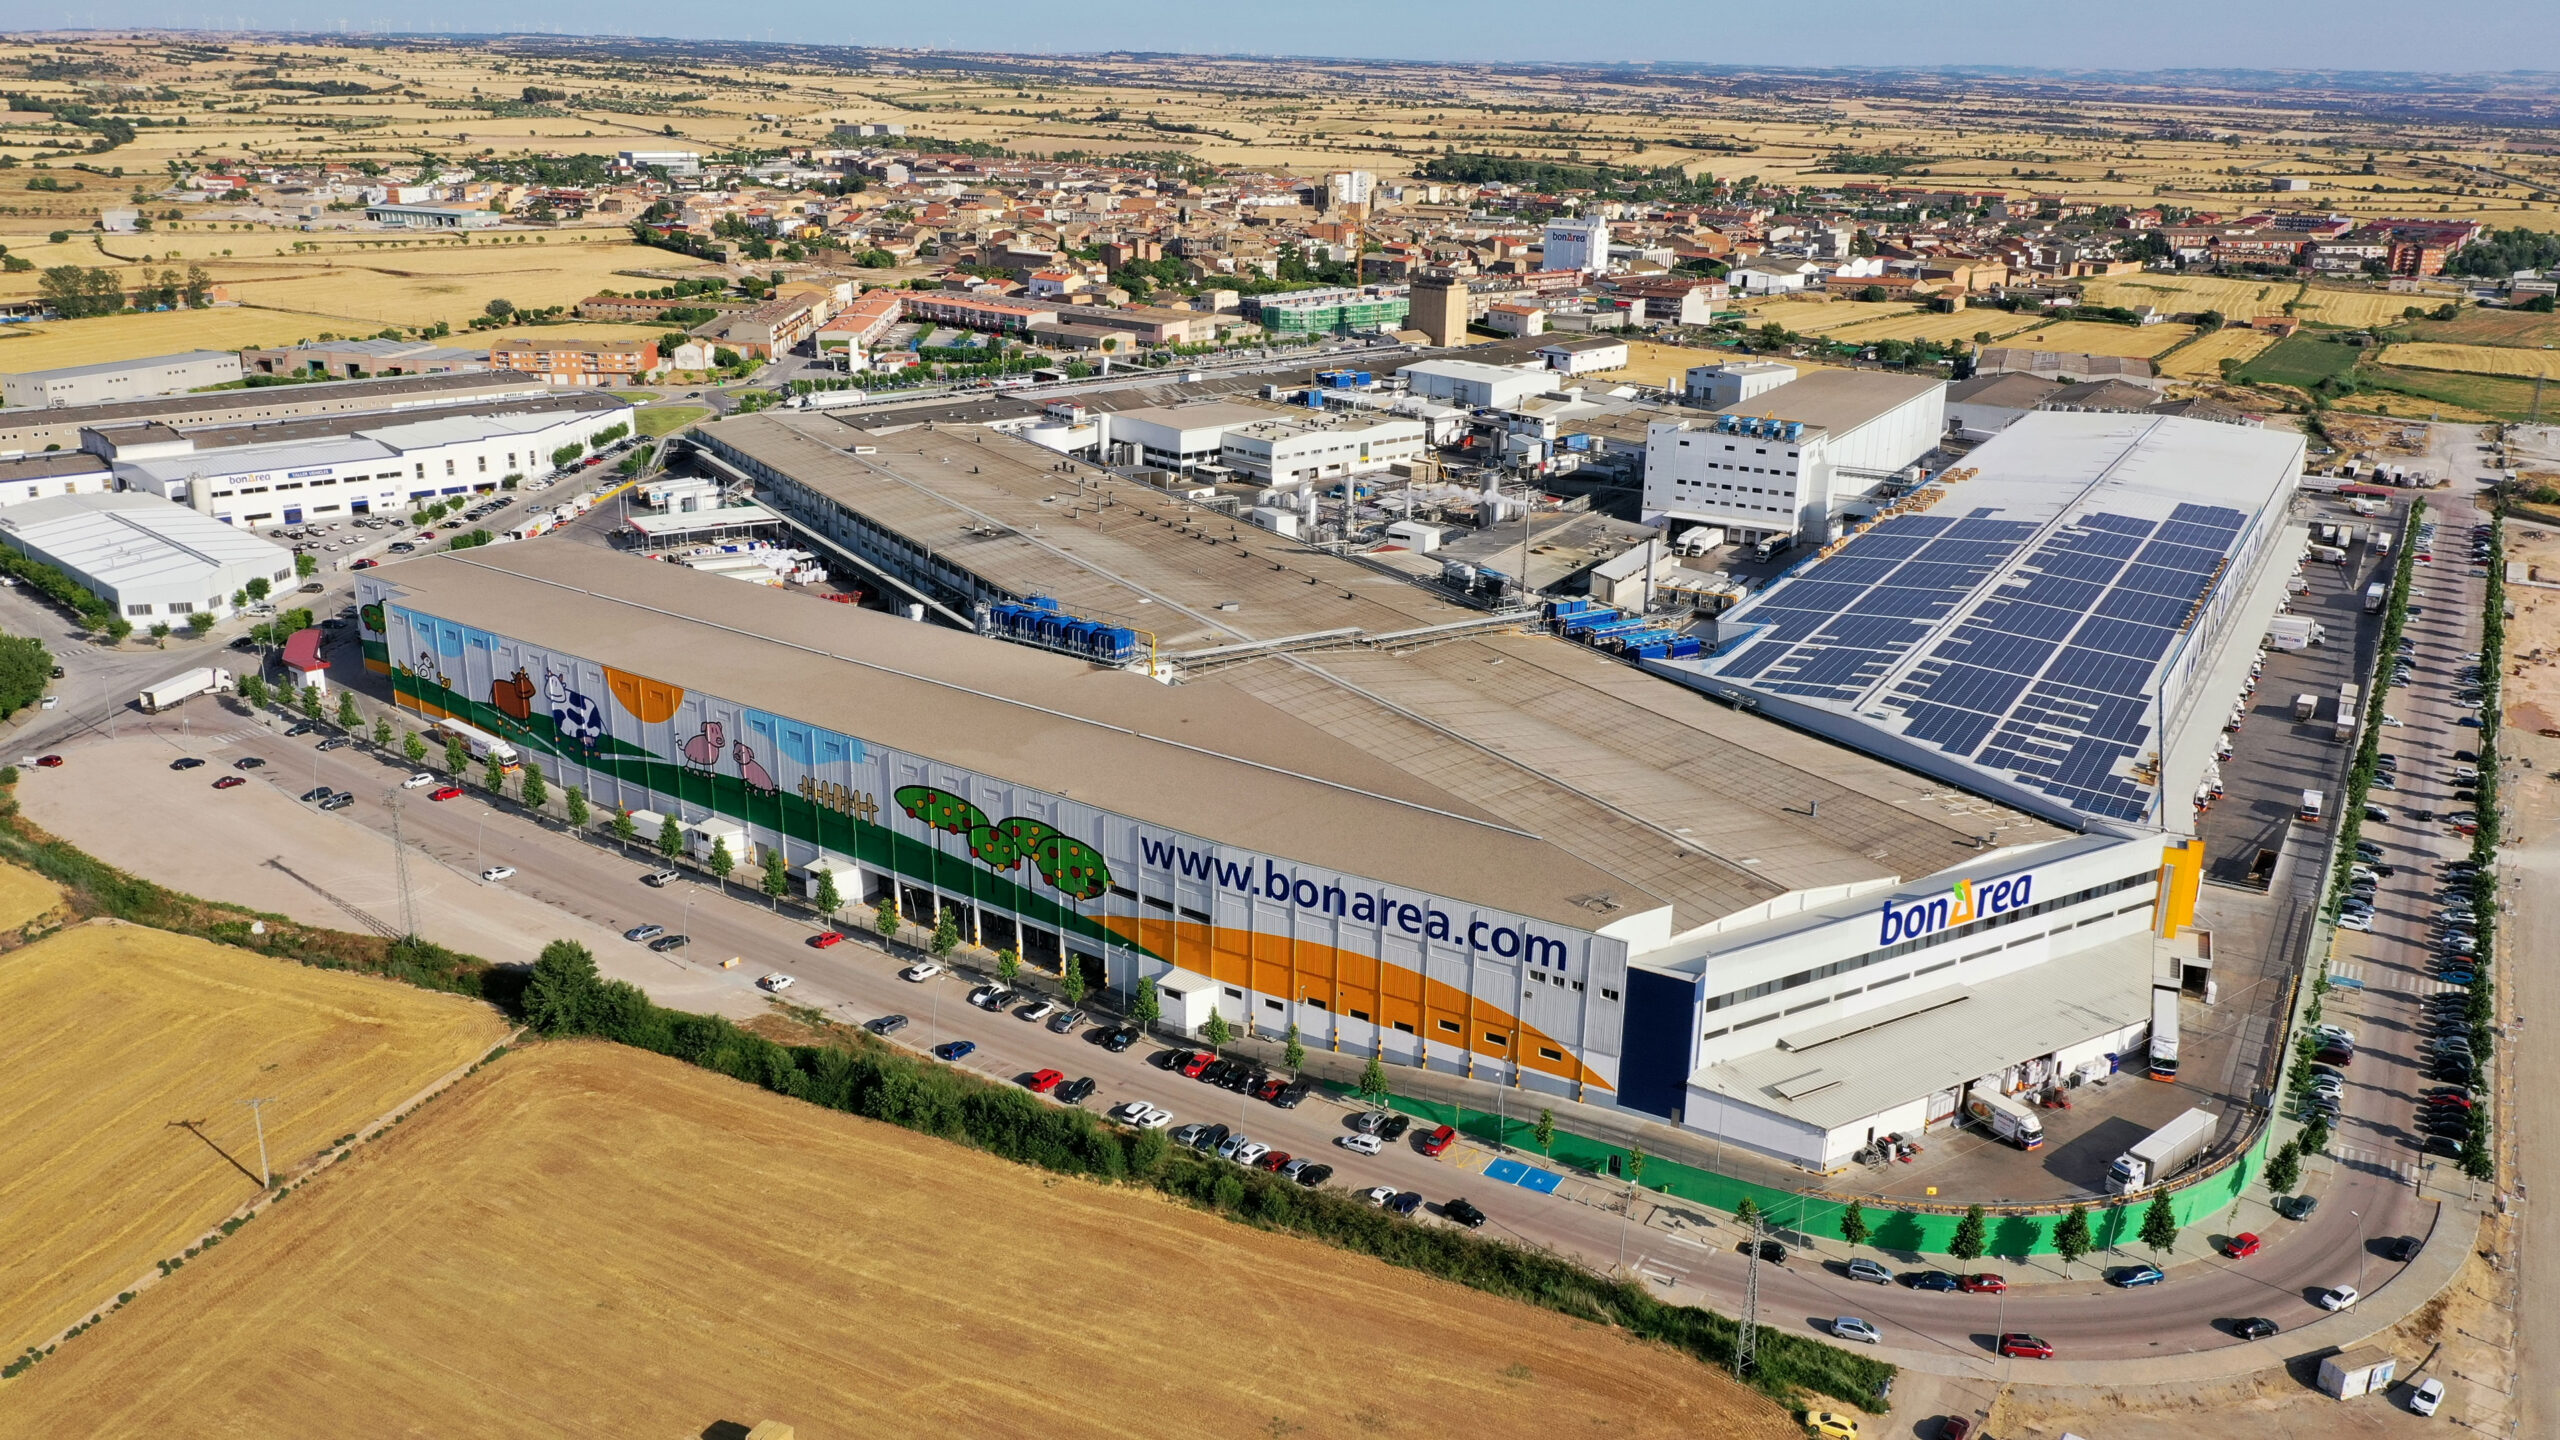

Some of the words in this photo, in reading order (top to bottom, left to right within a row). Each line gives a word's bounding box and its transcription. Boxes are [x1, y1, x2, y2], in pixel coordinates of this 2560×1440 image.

[1552, 231, 1586, 242] bonArea
[229, 473, 271, 484] bonArea
[1141, 836, 1568, 971] www.bonarea.com
[1880, 875, 2032, 946] bonArea
